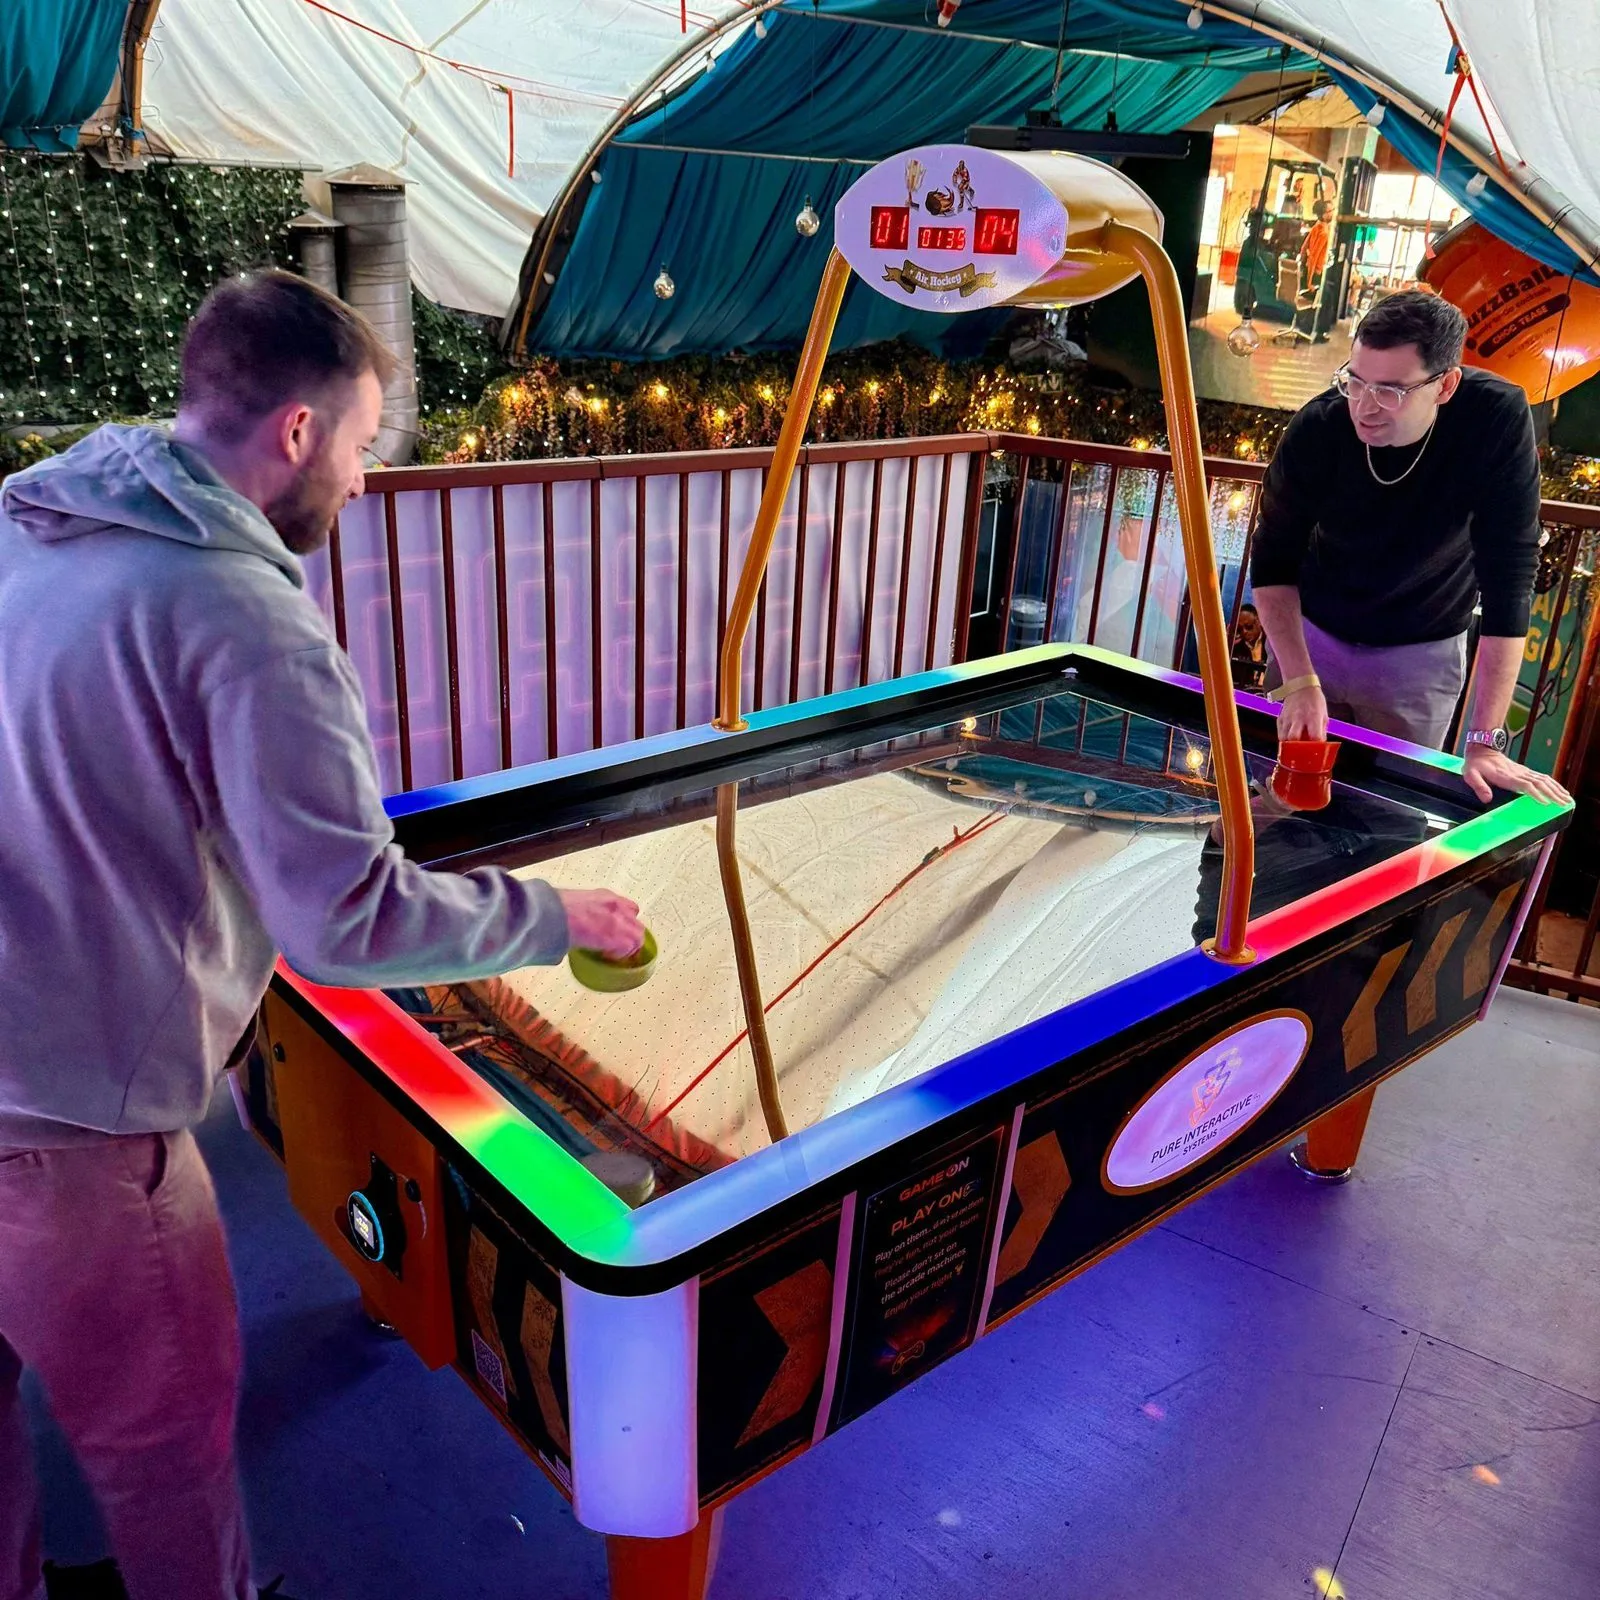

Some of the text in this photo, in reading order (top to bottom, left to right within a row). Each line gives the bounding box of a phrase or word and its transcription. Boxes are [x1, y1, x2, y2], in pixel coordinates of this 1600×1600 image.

[875, 212, 908, 244] 01
[979, 214, 1017, 249] 04
[915, 271, 962, 287] Air Hockey
[1467, 264, 1564, 329] uzzBall
[1492, 322, 1517, 344] CHOC
[1519, 305, 1549, 326] TEASE
[1151, 1094, 1253, 1164] PURE INTERACTIVE
[1182, 1128, 1218, 1156] SYSTEMS
[900, 1171, 945, 1201] GAME
[891, 1200, 937, 1236] PLAY
[875, 1248, 893, 1264] Play
[894, 1241, 905, 1252] on
[885, 1241, 957, 1291] Please don't sit on
[881, 1290, 896, 1304] the
[897, 1272, 926, 1294] arcade
[884, 1298, 909, 1319] Enjoy
[909, 1285, 930, 1305] your
